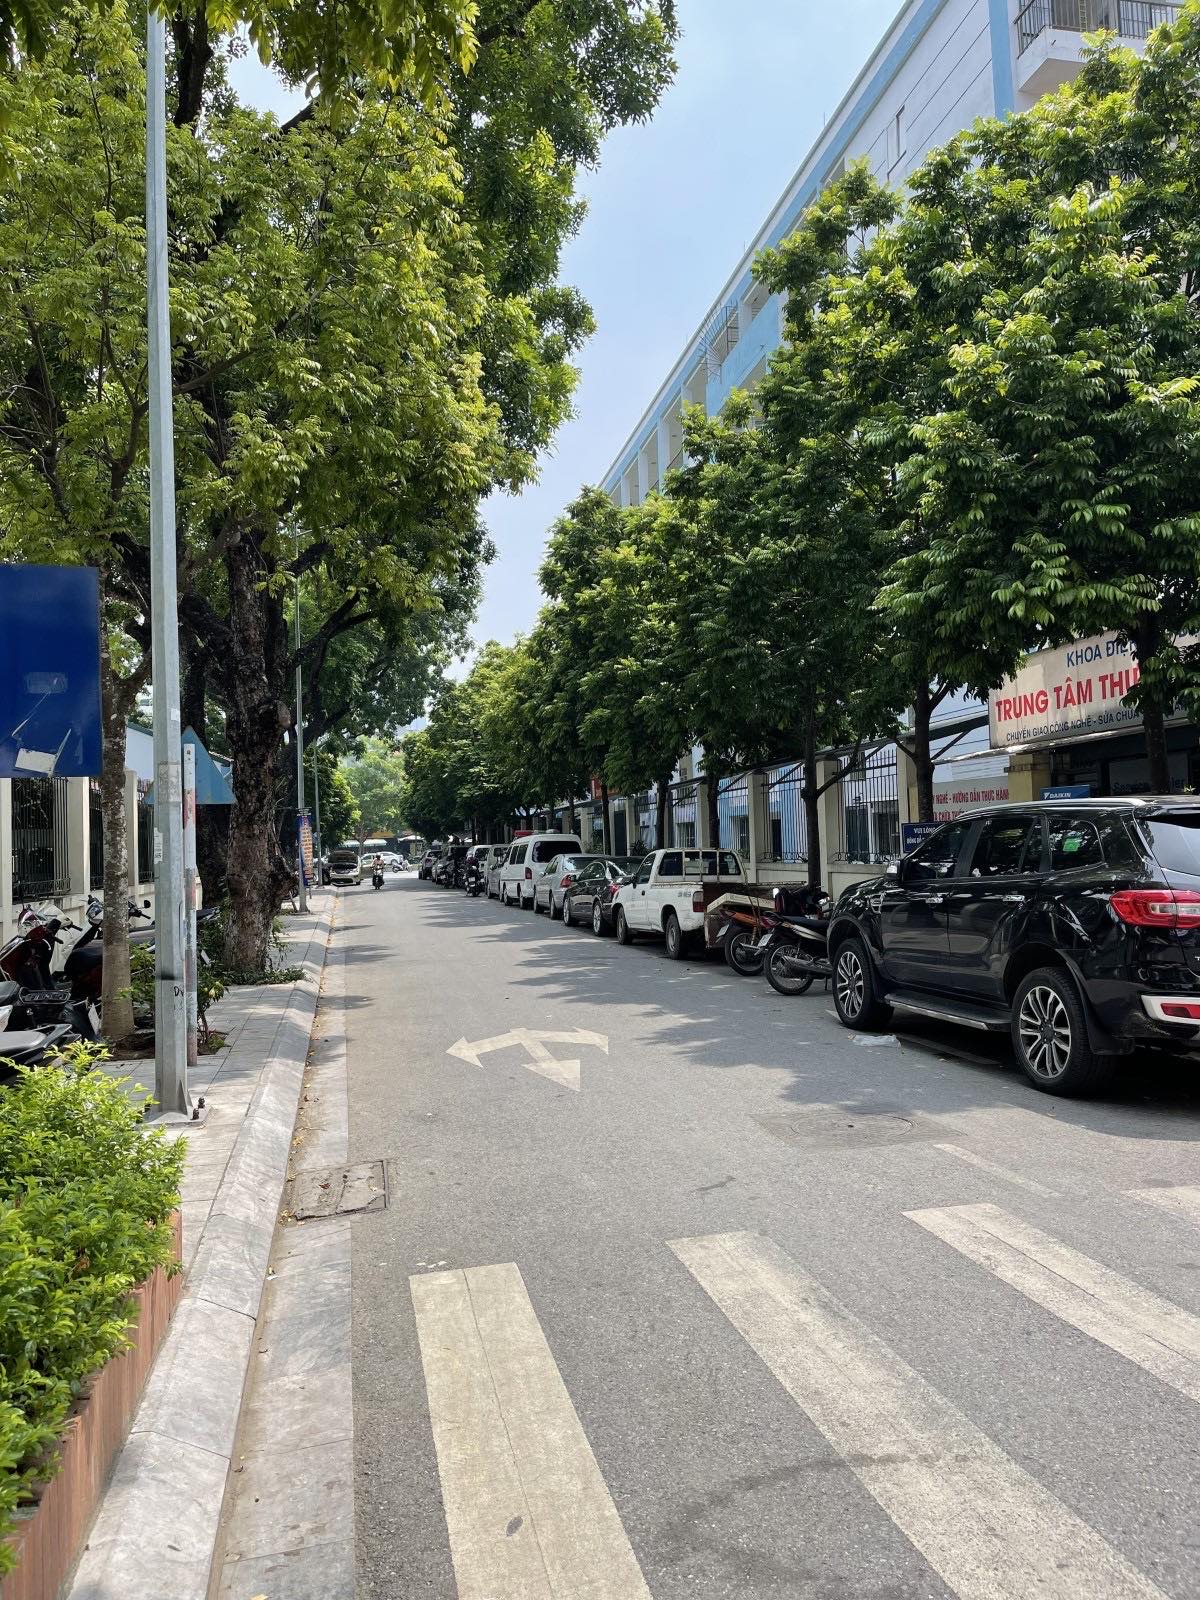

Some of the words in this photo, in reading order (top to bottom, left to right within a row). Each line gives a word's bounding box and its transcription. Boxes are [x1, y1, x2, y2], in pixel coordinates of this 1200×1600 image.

[1067, 644, 1102, 667] KHOA
[995, 690, 1048, 722] TRUNG
[1054, 676, 1092, 709] TÂM
[1032, 725, 1048, 737] GIAO
[1050, 721, 1070, 733] CÔNG
